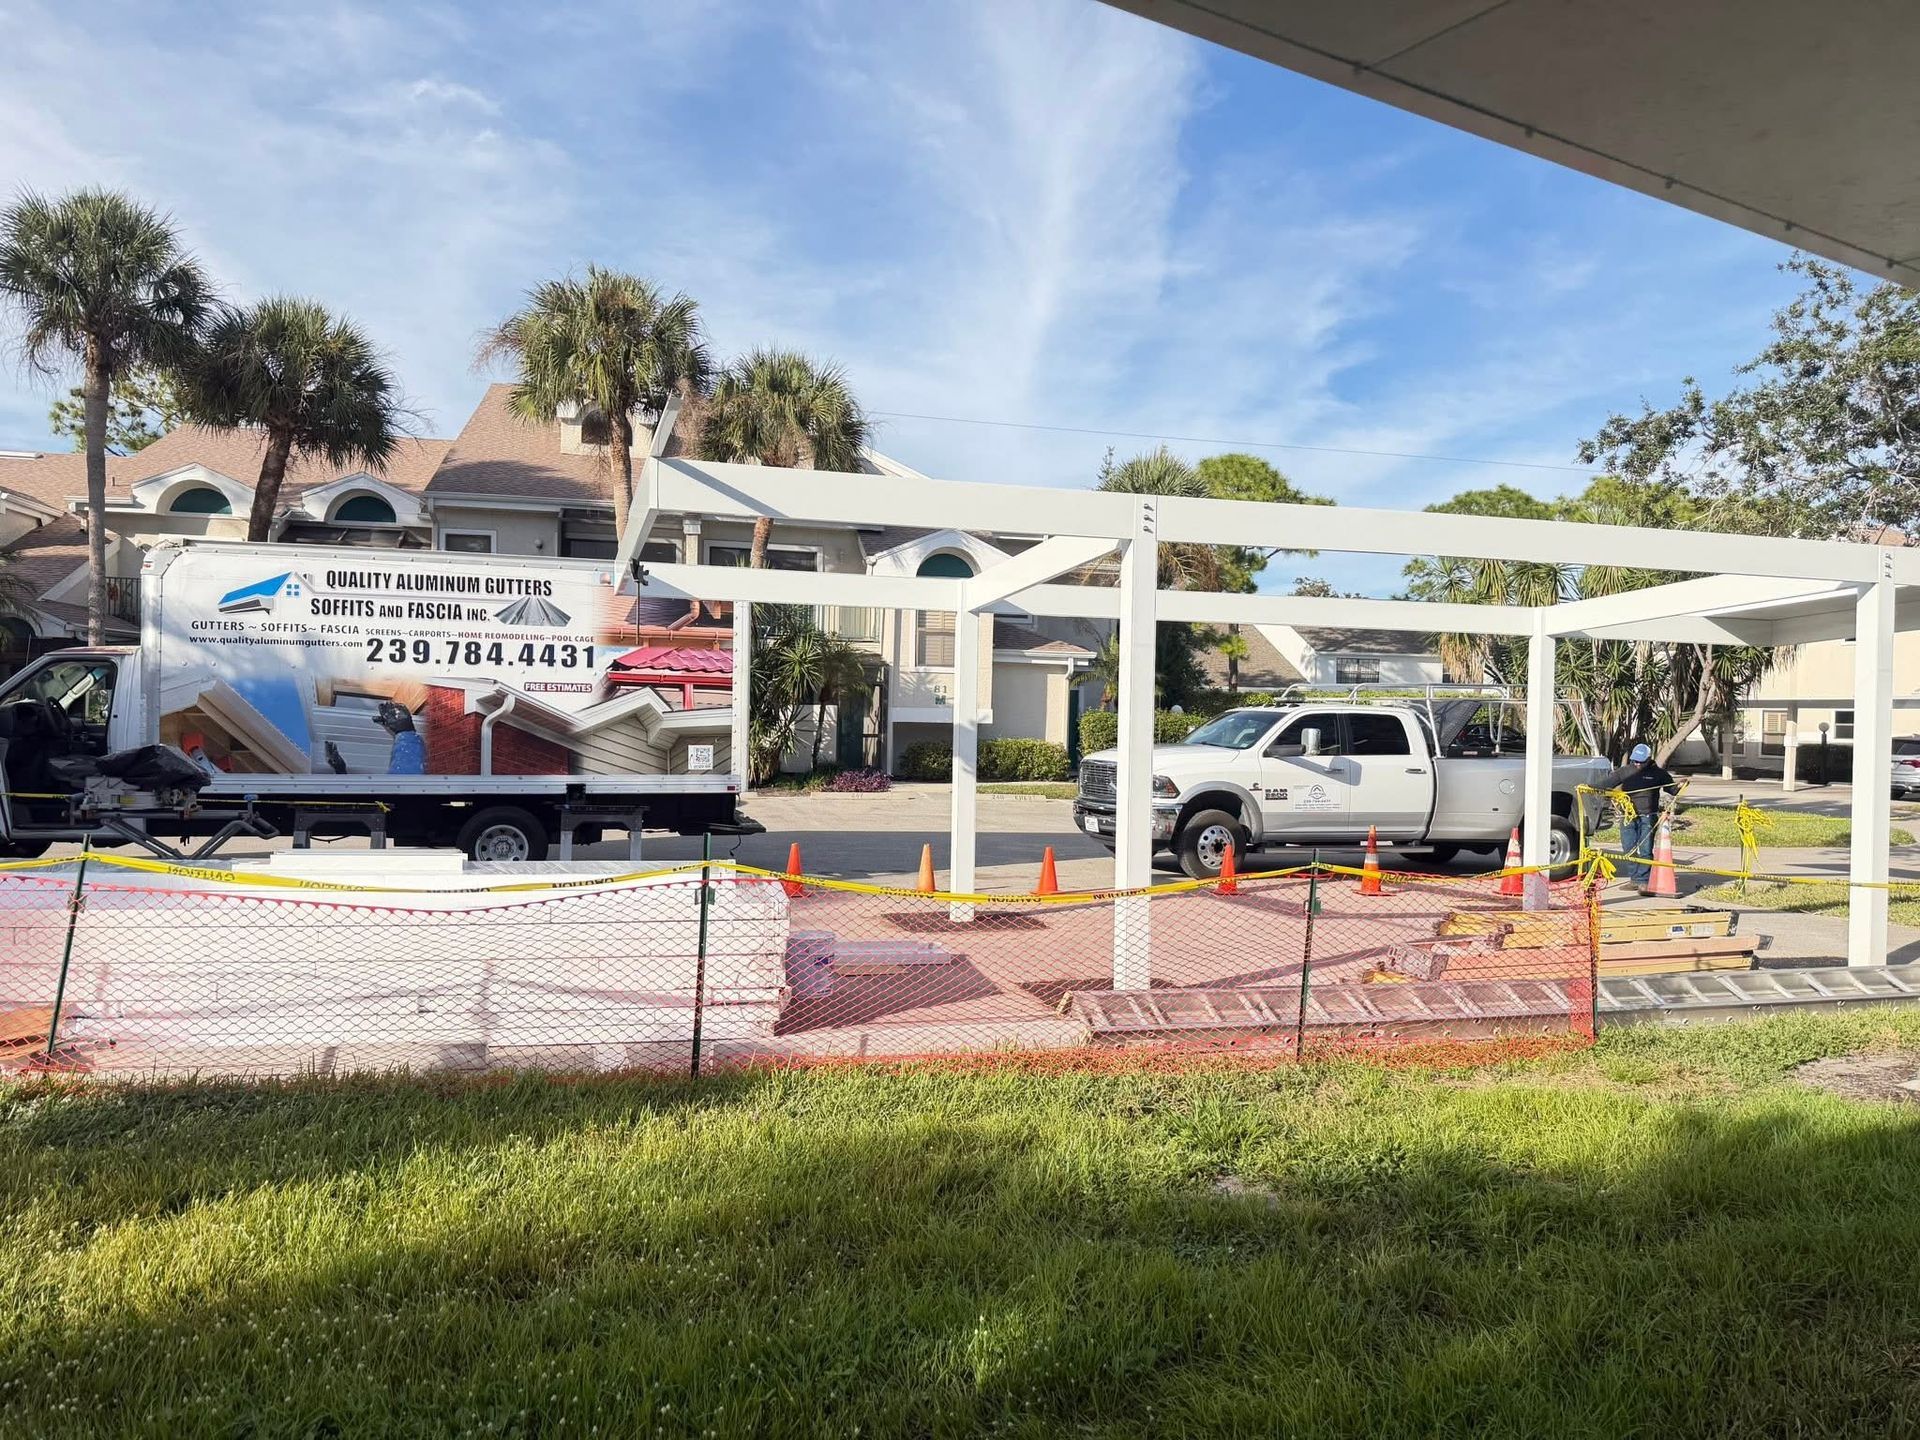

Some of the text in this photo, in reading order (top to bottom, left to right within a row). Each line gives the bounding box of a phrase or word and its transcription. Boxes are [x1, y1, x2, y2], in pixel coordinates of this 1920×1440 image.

[326, 570, 552, 597] QUALITY ALUMINUM GUTTERS
[310, 598, 490, 622] SOFFITS AND FASCIA INC.
[191, 620, 245, 631] GUTTERS
[320, 624, 360, 635] FASCIA
[189, 635, 363, 648] www.qualityaluminumgutters.com
[574, 635, 595, 643] CAGE
[366, 638, 595, 668] 239.784.4431
[525, 682, 592, 692] FREE ESTIMATES
